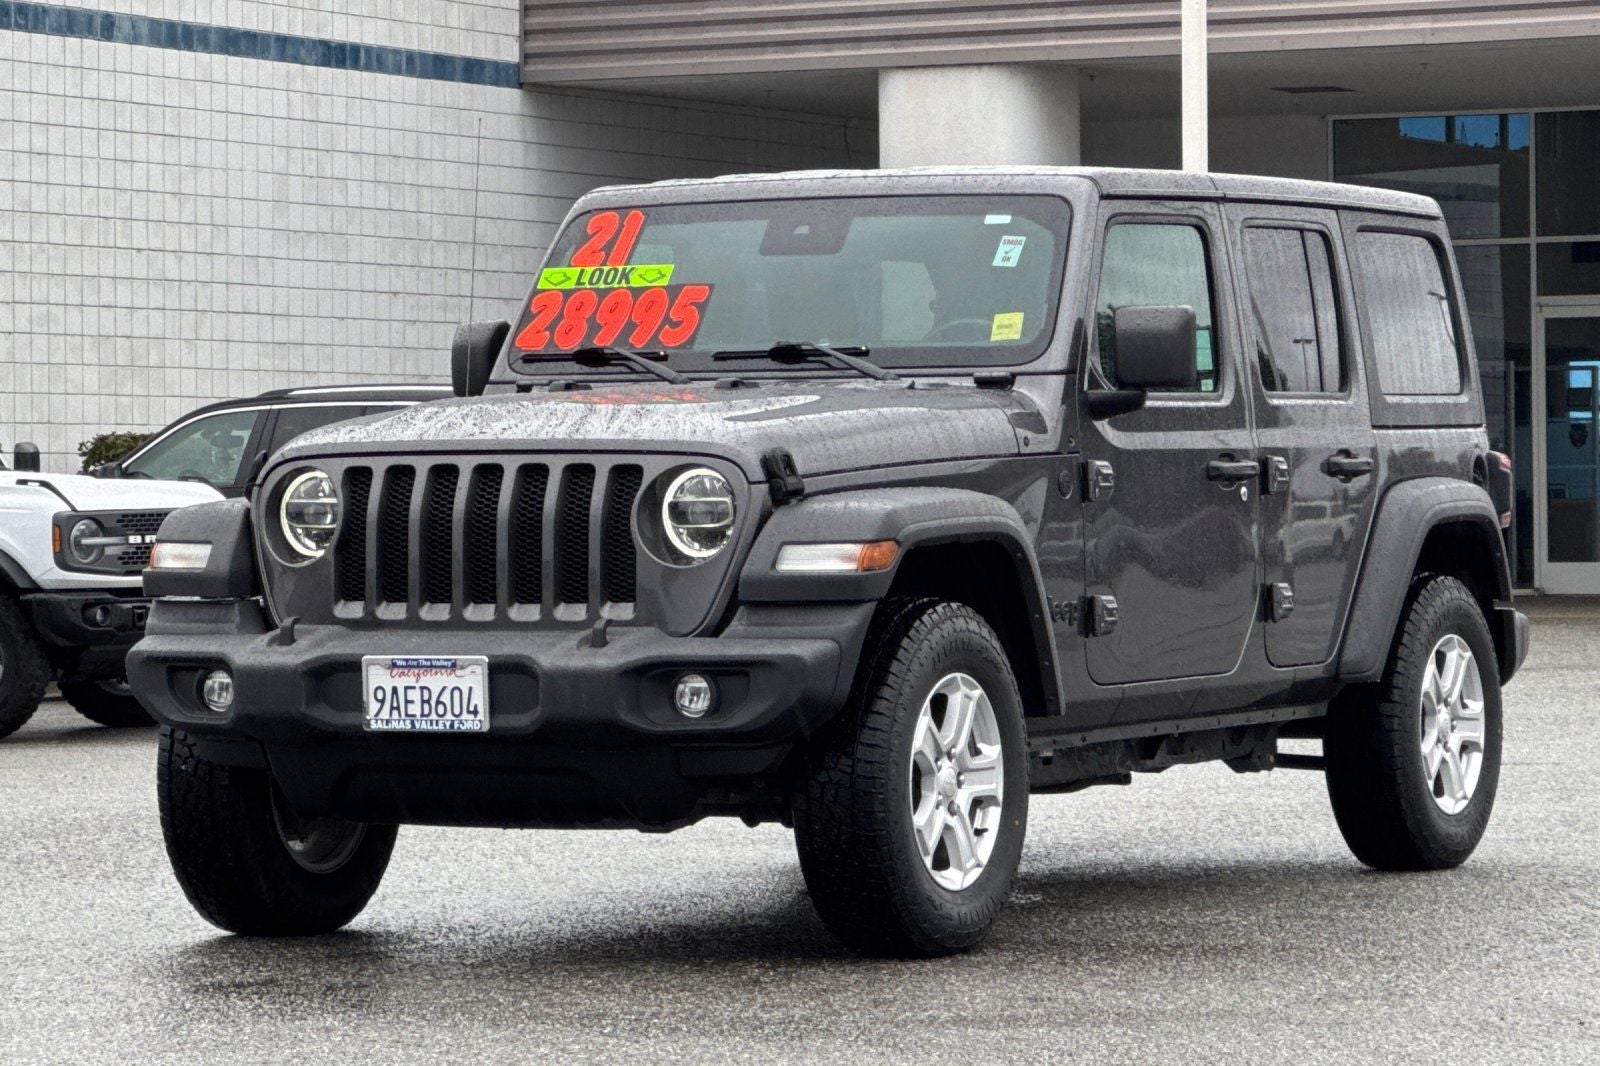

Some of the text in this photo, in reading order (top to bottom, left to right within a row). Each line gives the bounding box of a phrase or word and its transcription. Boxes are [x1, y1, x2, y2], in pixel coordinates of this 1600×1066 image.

[571, 209, 645, 265] 21
[574, 266, 636, 286] LOOK
[515, 285, 709, 350] 28995
[128, 535, 156, 544] BR
[373, 686, 480, 718] 9AEB604
[414, 720, 451, 729] VALLEY
[454, 720, 481, 729] FORD
